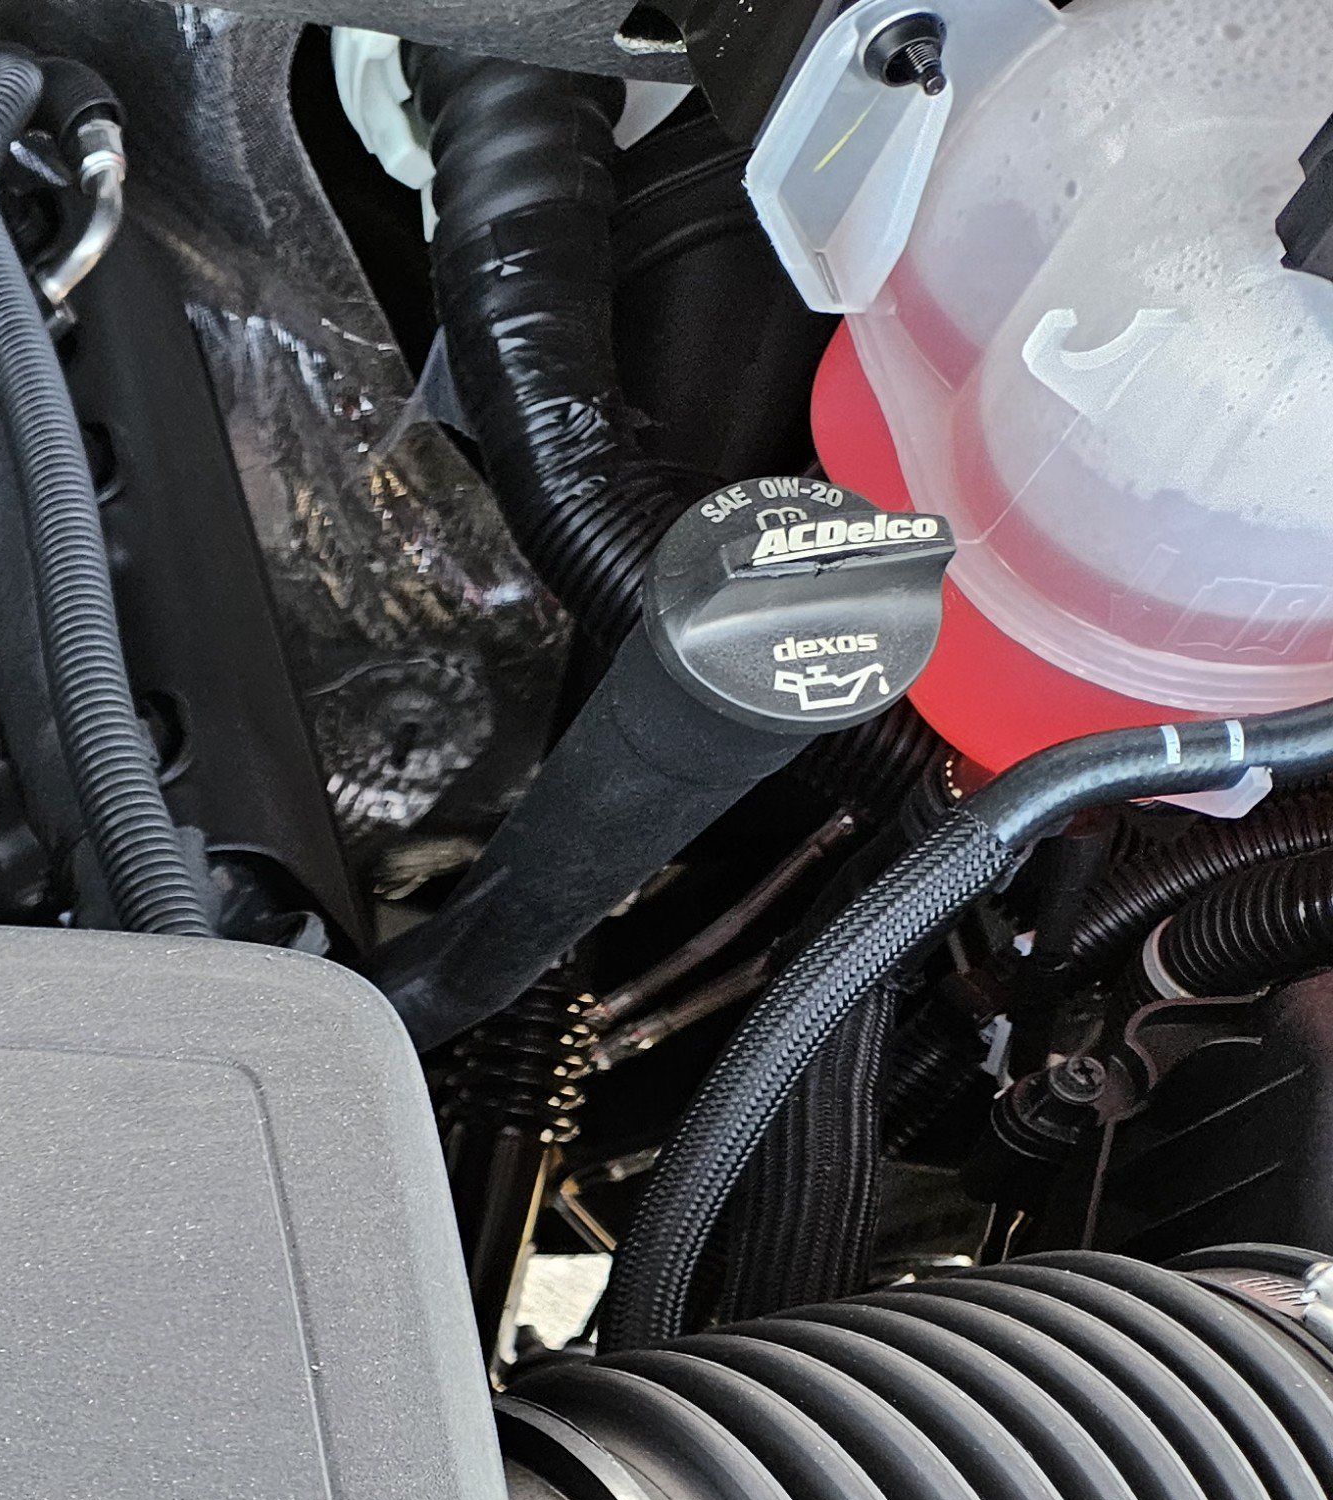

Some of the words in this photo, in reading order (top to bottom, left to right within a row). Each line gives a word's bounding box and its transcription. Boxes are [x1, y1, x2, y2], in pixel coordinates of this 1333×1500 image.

[700, 485, 753, 523] SAE
[758, 477, 844, 508] 0W-20
[751, 514, 939, 560] ACDelco
[773, 633, 879, 662] dexos
